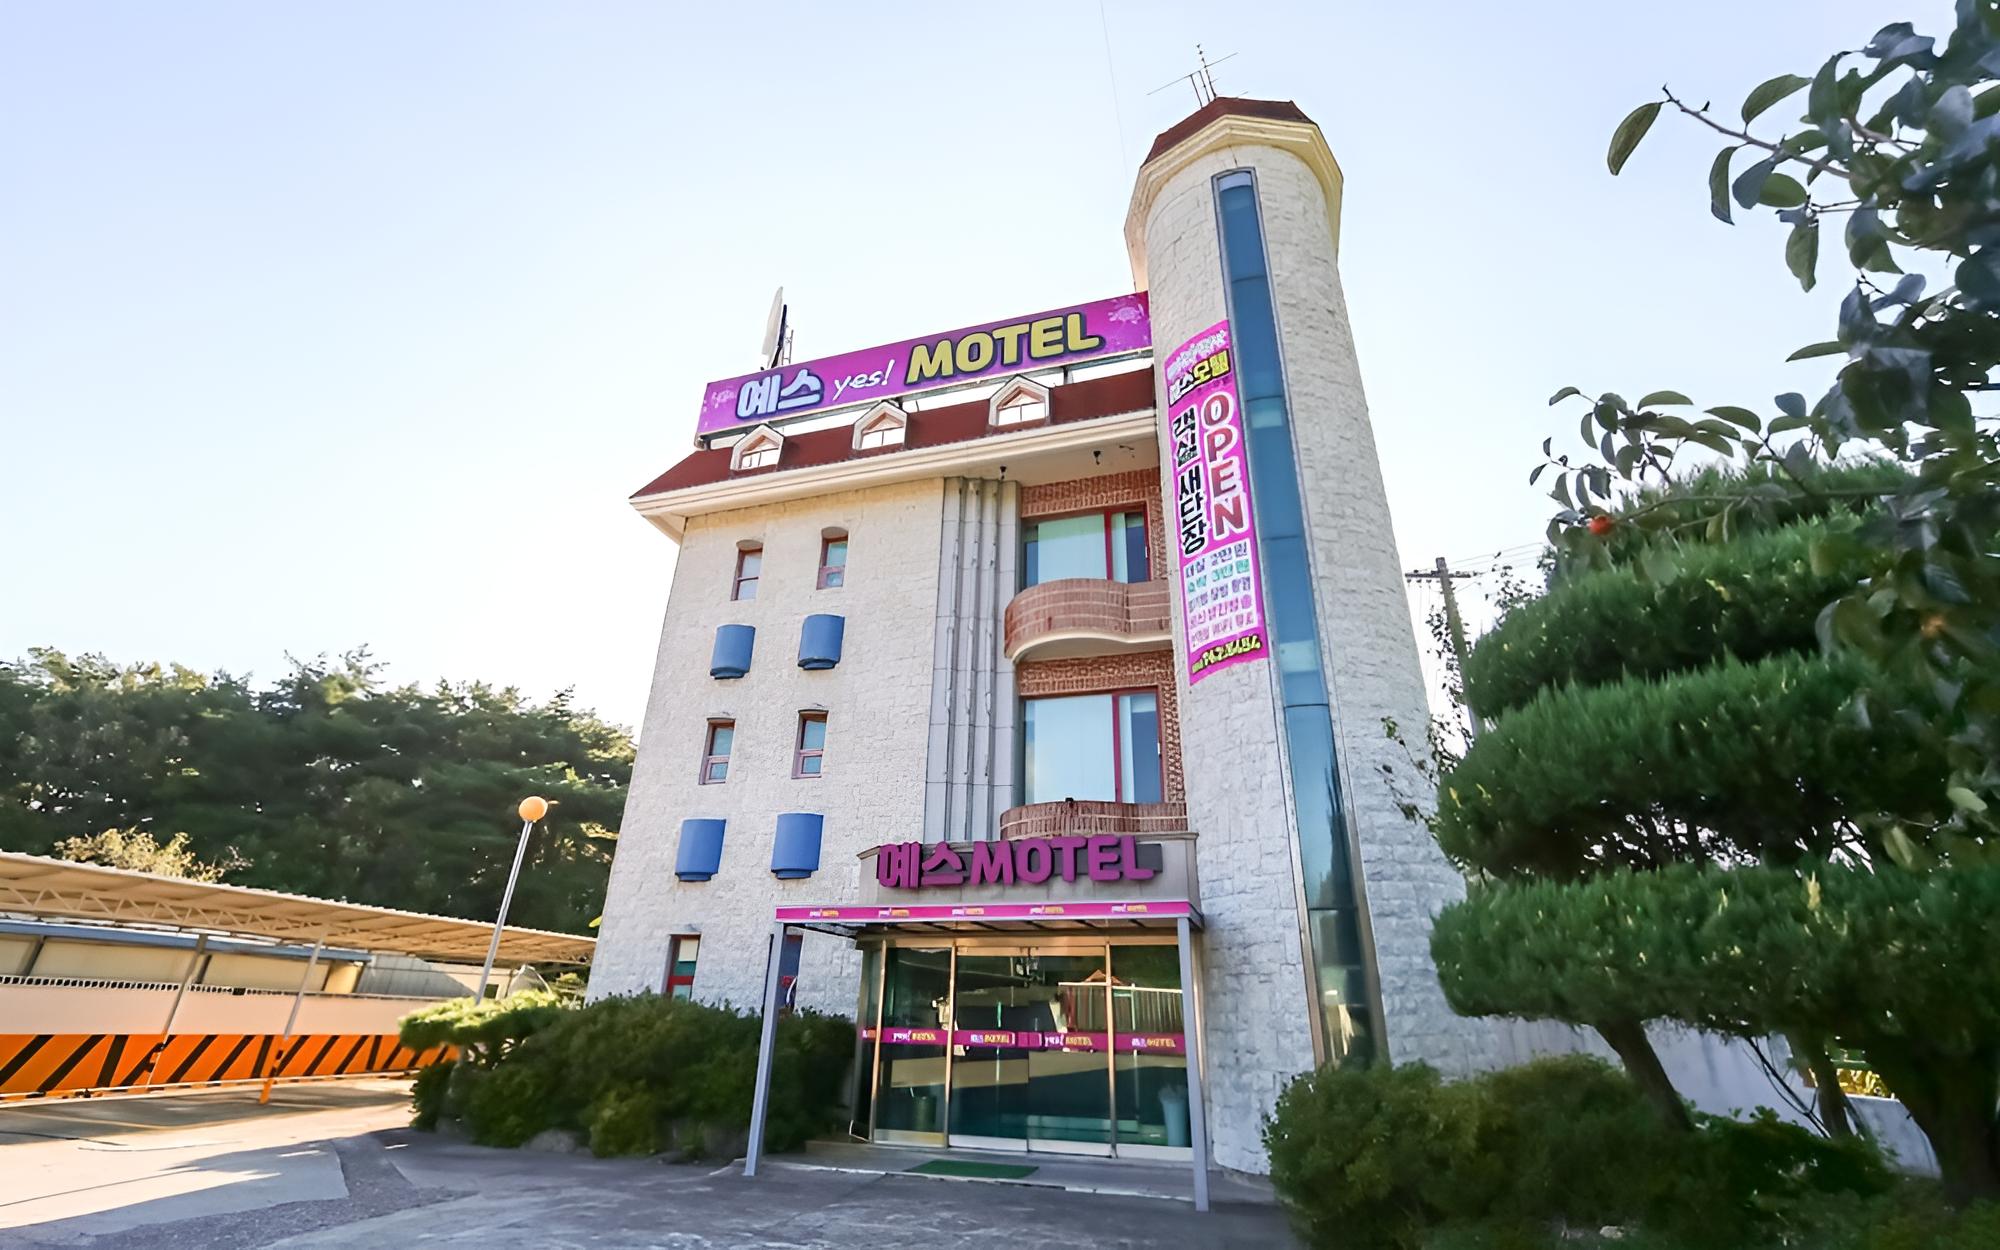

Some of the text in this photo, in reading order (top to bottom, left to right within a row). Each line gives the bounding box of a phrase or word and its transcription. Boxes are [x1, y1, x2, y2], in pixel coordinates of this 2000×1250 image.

[735, 313, 1105, 420] 예스 yes! MOTEL
[1179, 465, 1208, 556] 새단장
[1203, 394, 1246, 537] OPEN
